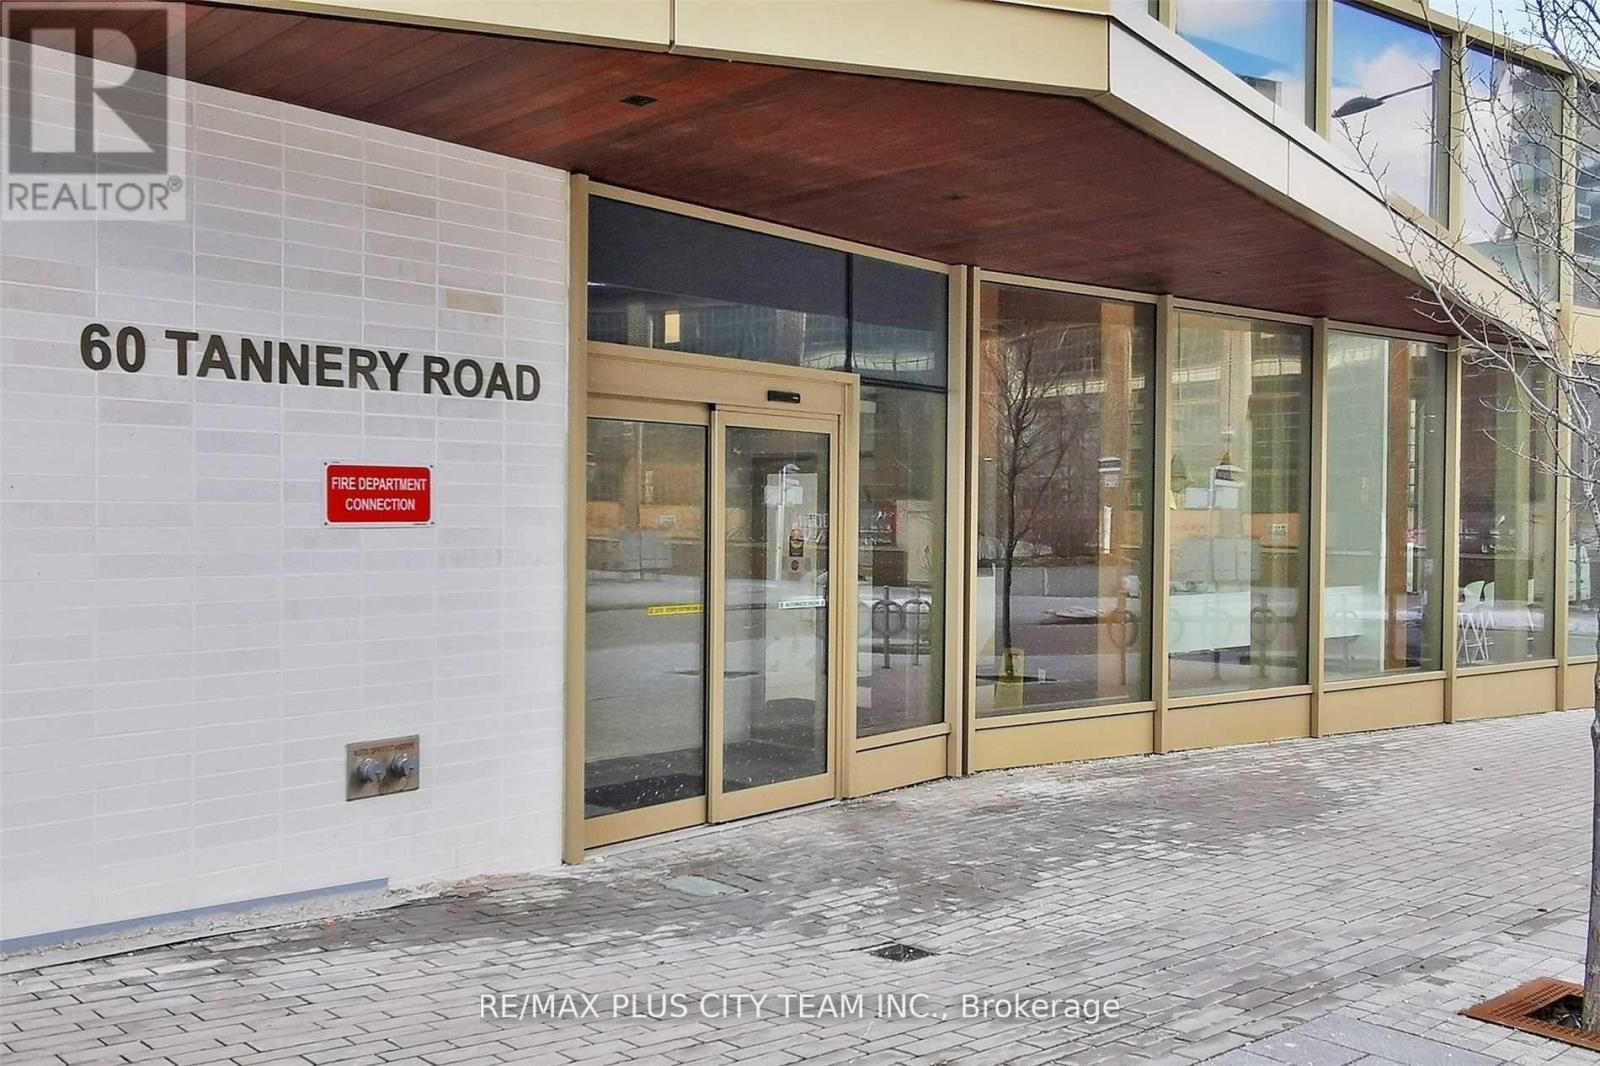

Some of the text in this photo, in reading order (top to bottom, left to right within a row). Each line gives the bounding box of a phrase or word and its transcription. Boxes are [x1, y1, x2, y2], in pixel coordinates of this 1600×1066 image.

[80, 323, 541, 402] 60 TANNERY ROAD
[331, 477, 427, 491] FIRE DEPARTMENT
[345, 498, 416, 511] CONNECTION
